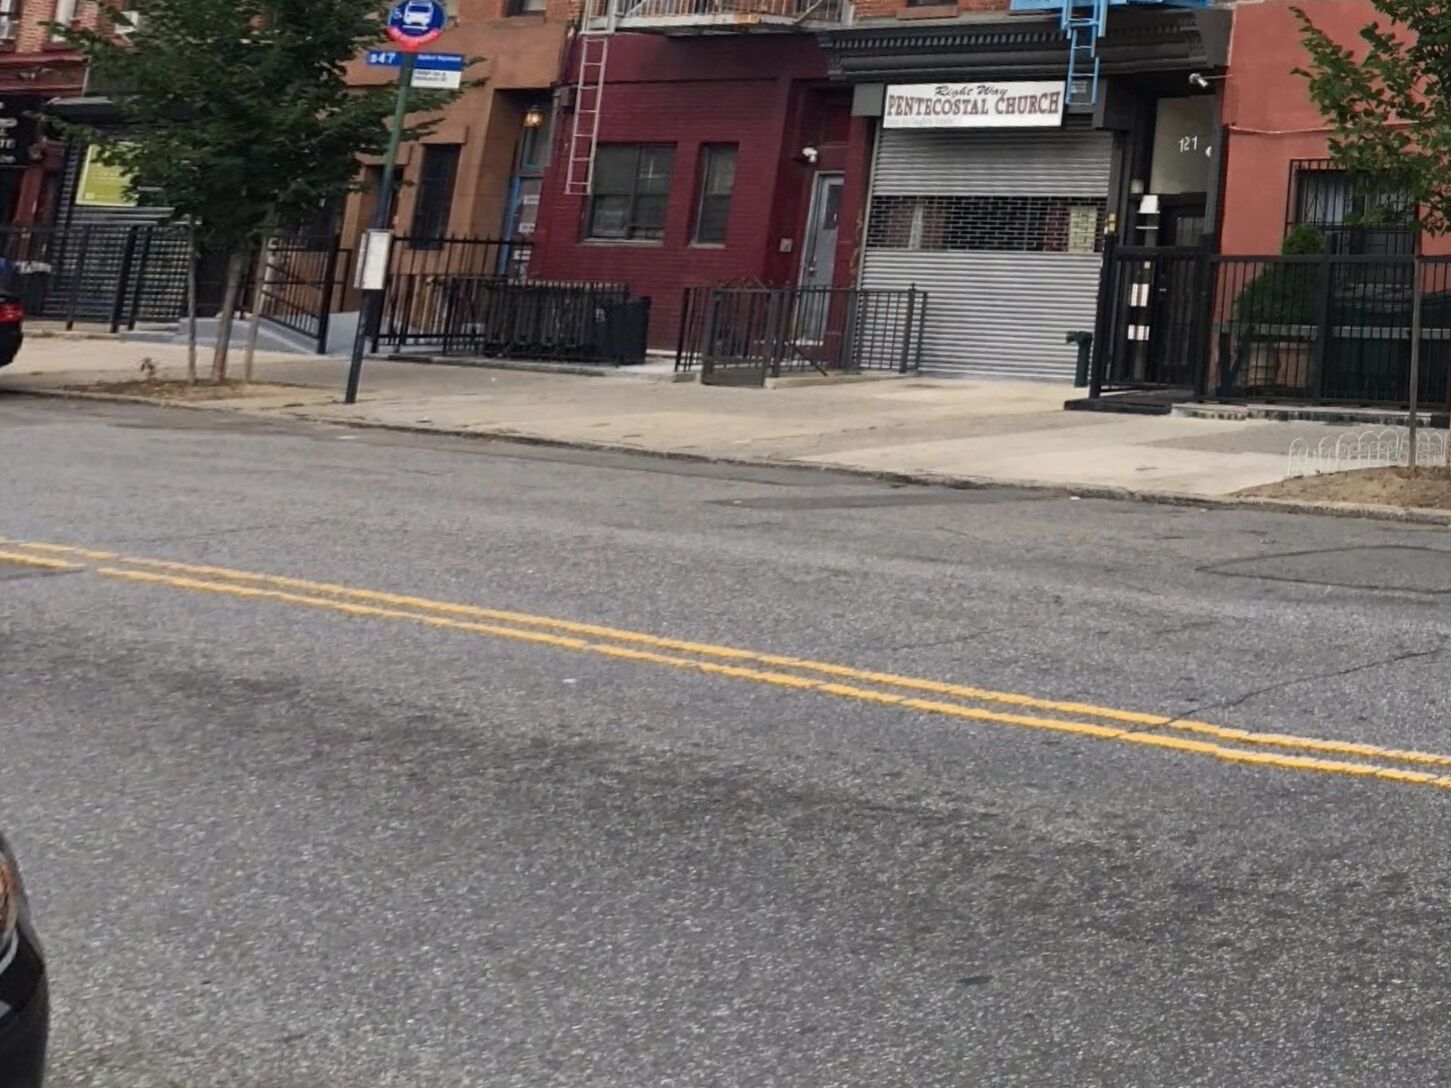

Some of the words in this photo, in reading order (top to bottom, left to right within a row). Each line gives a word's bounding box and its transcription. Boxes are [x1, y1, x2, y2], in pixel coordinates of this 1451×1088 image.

[935, 85, 974, 98] Right
[977, 84, 1008, 98] Way
[887, 94, 989, 116] PENTECOSTAL
[994, 91, 1061, 115] CHURCH
